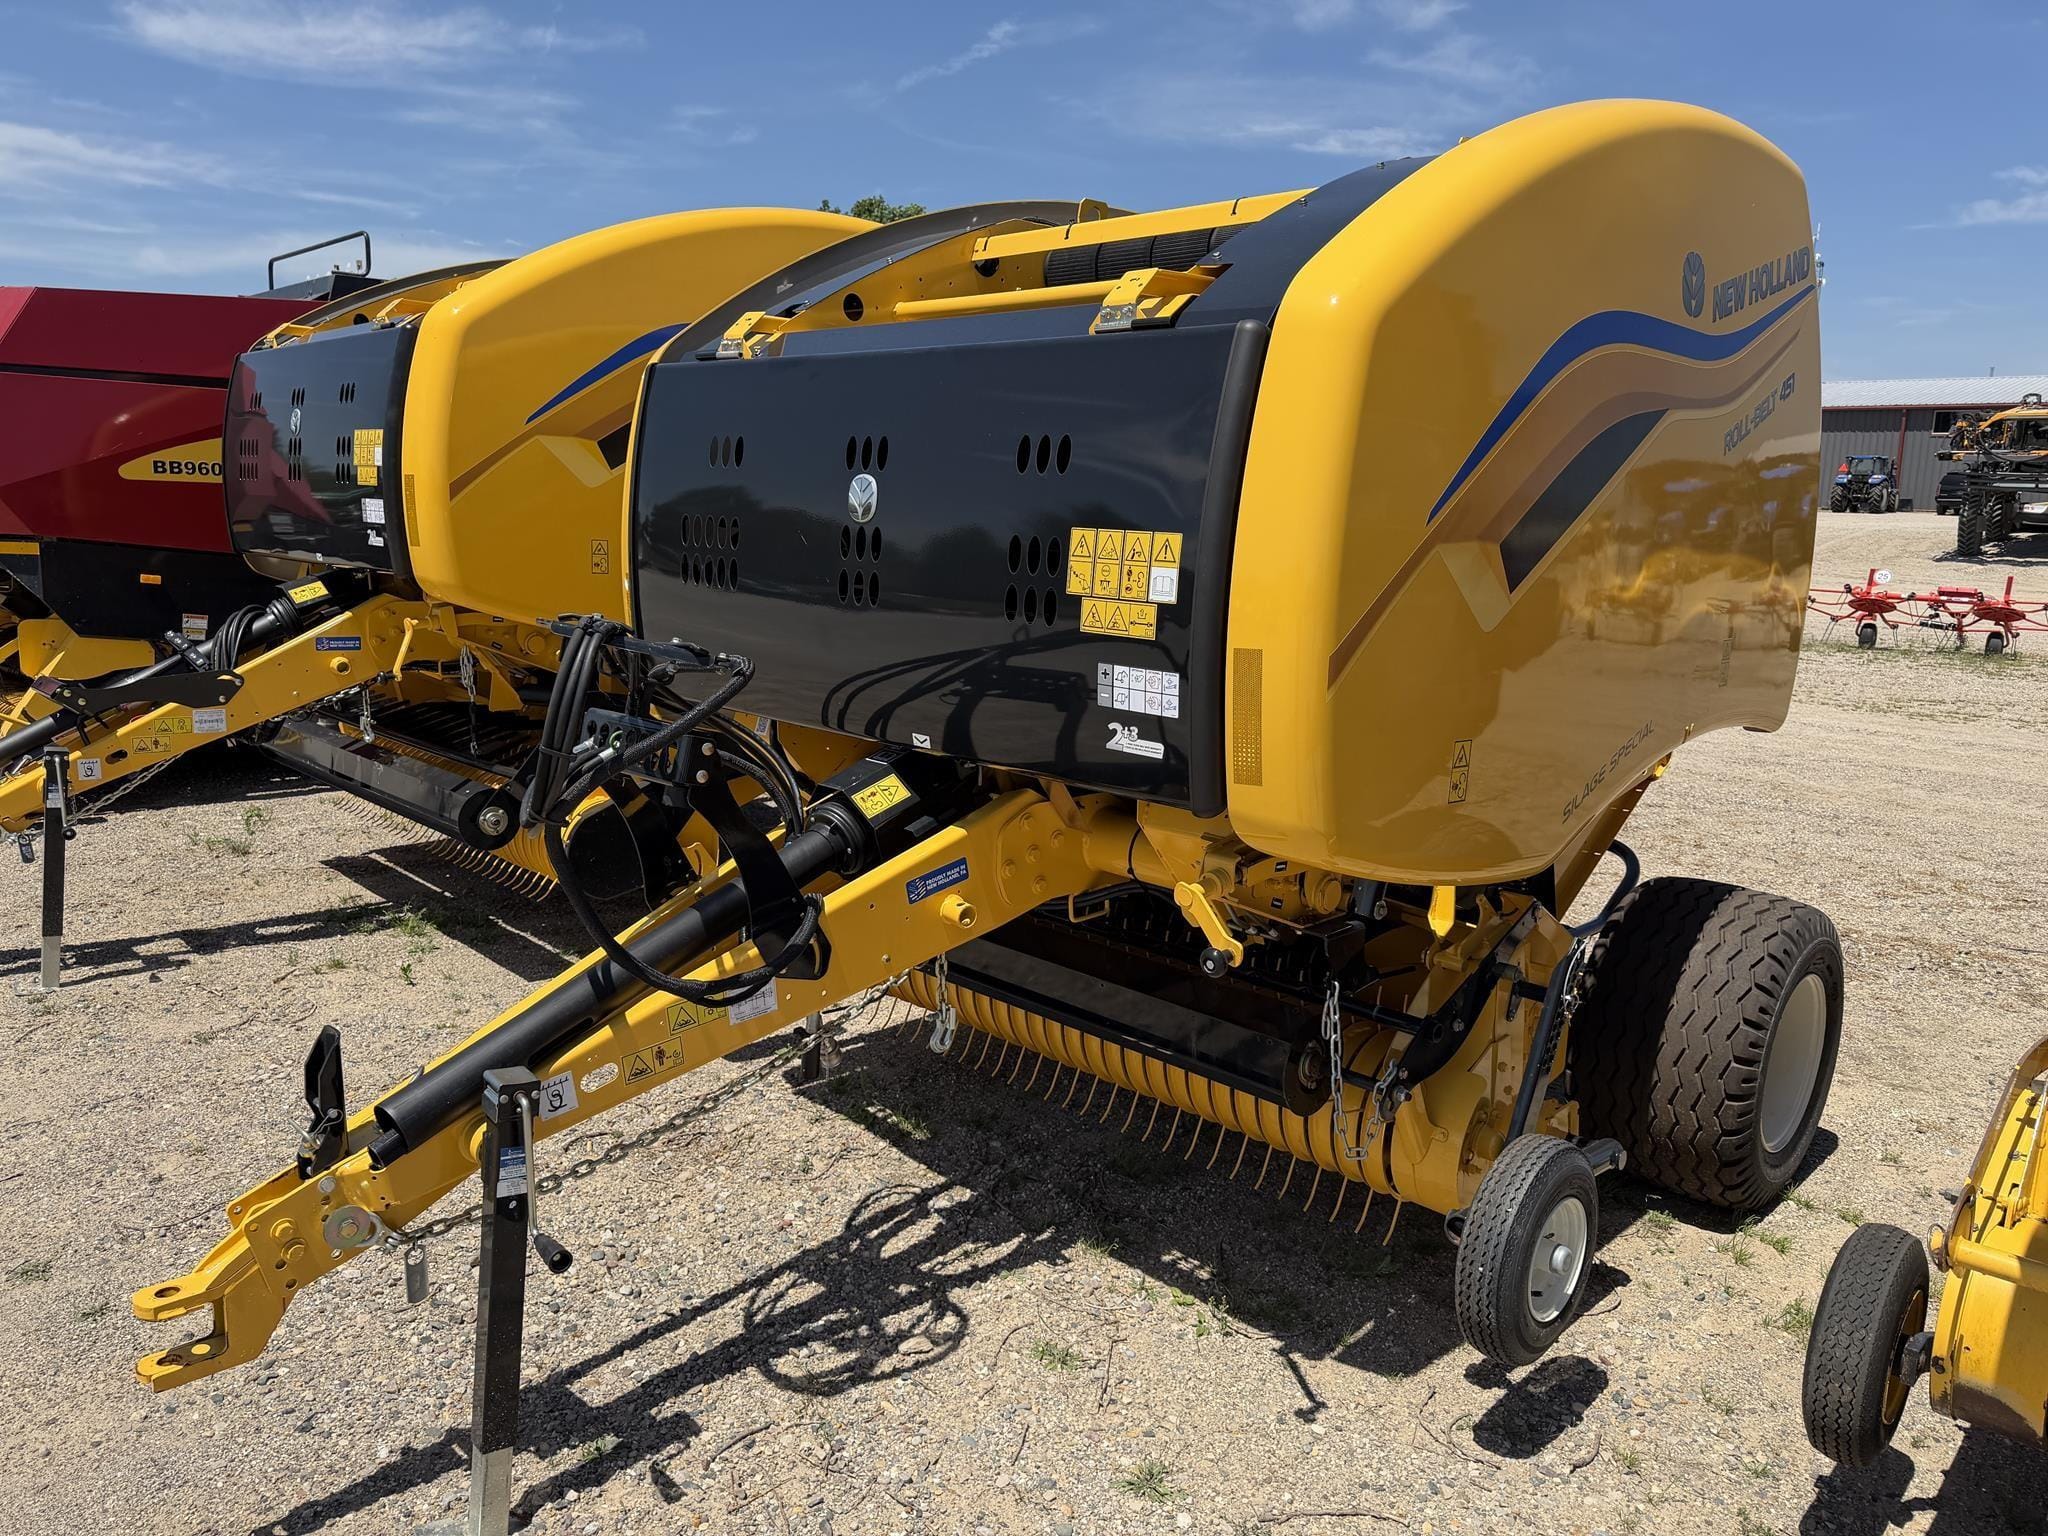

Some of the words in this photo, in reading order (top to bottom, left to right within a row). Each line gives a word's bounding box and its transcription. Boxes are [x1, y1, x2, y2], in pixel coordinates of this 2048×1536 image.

[1712, 272, 1747, 323] NEW
[1749, 246, 1811, 305] HOLLAND
[1723, 388, 1777, 456] ROLL-BELT
[1780, 372, 1795, 401] 451
[1562, 764, 1606, 824] SILAGE
[1609, 720, 1654, 773] SPECIAL
[926, 872, 946, 885] PROUDLY
[926, 882, 938, 890] NEW
